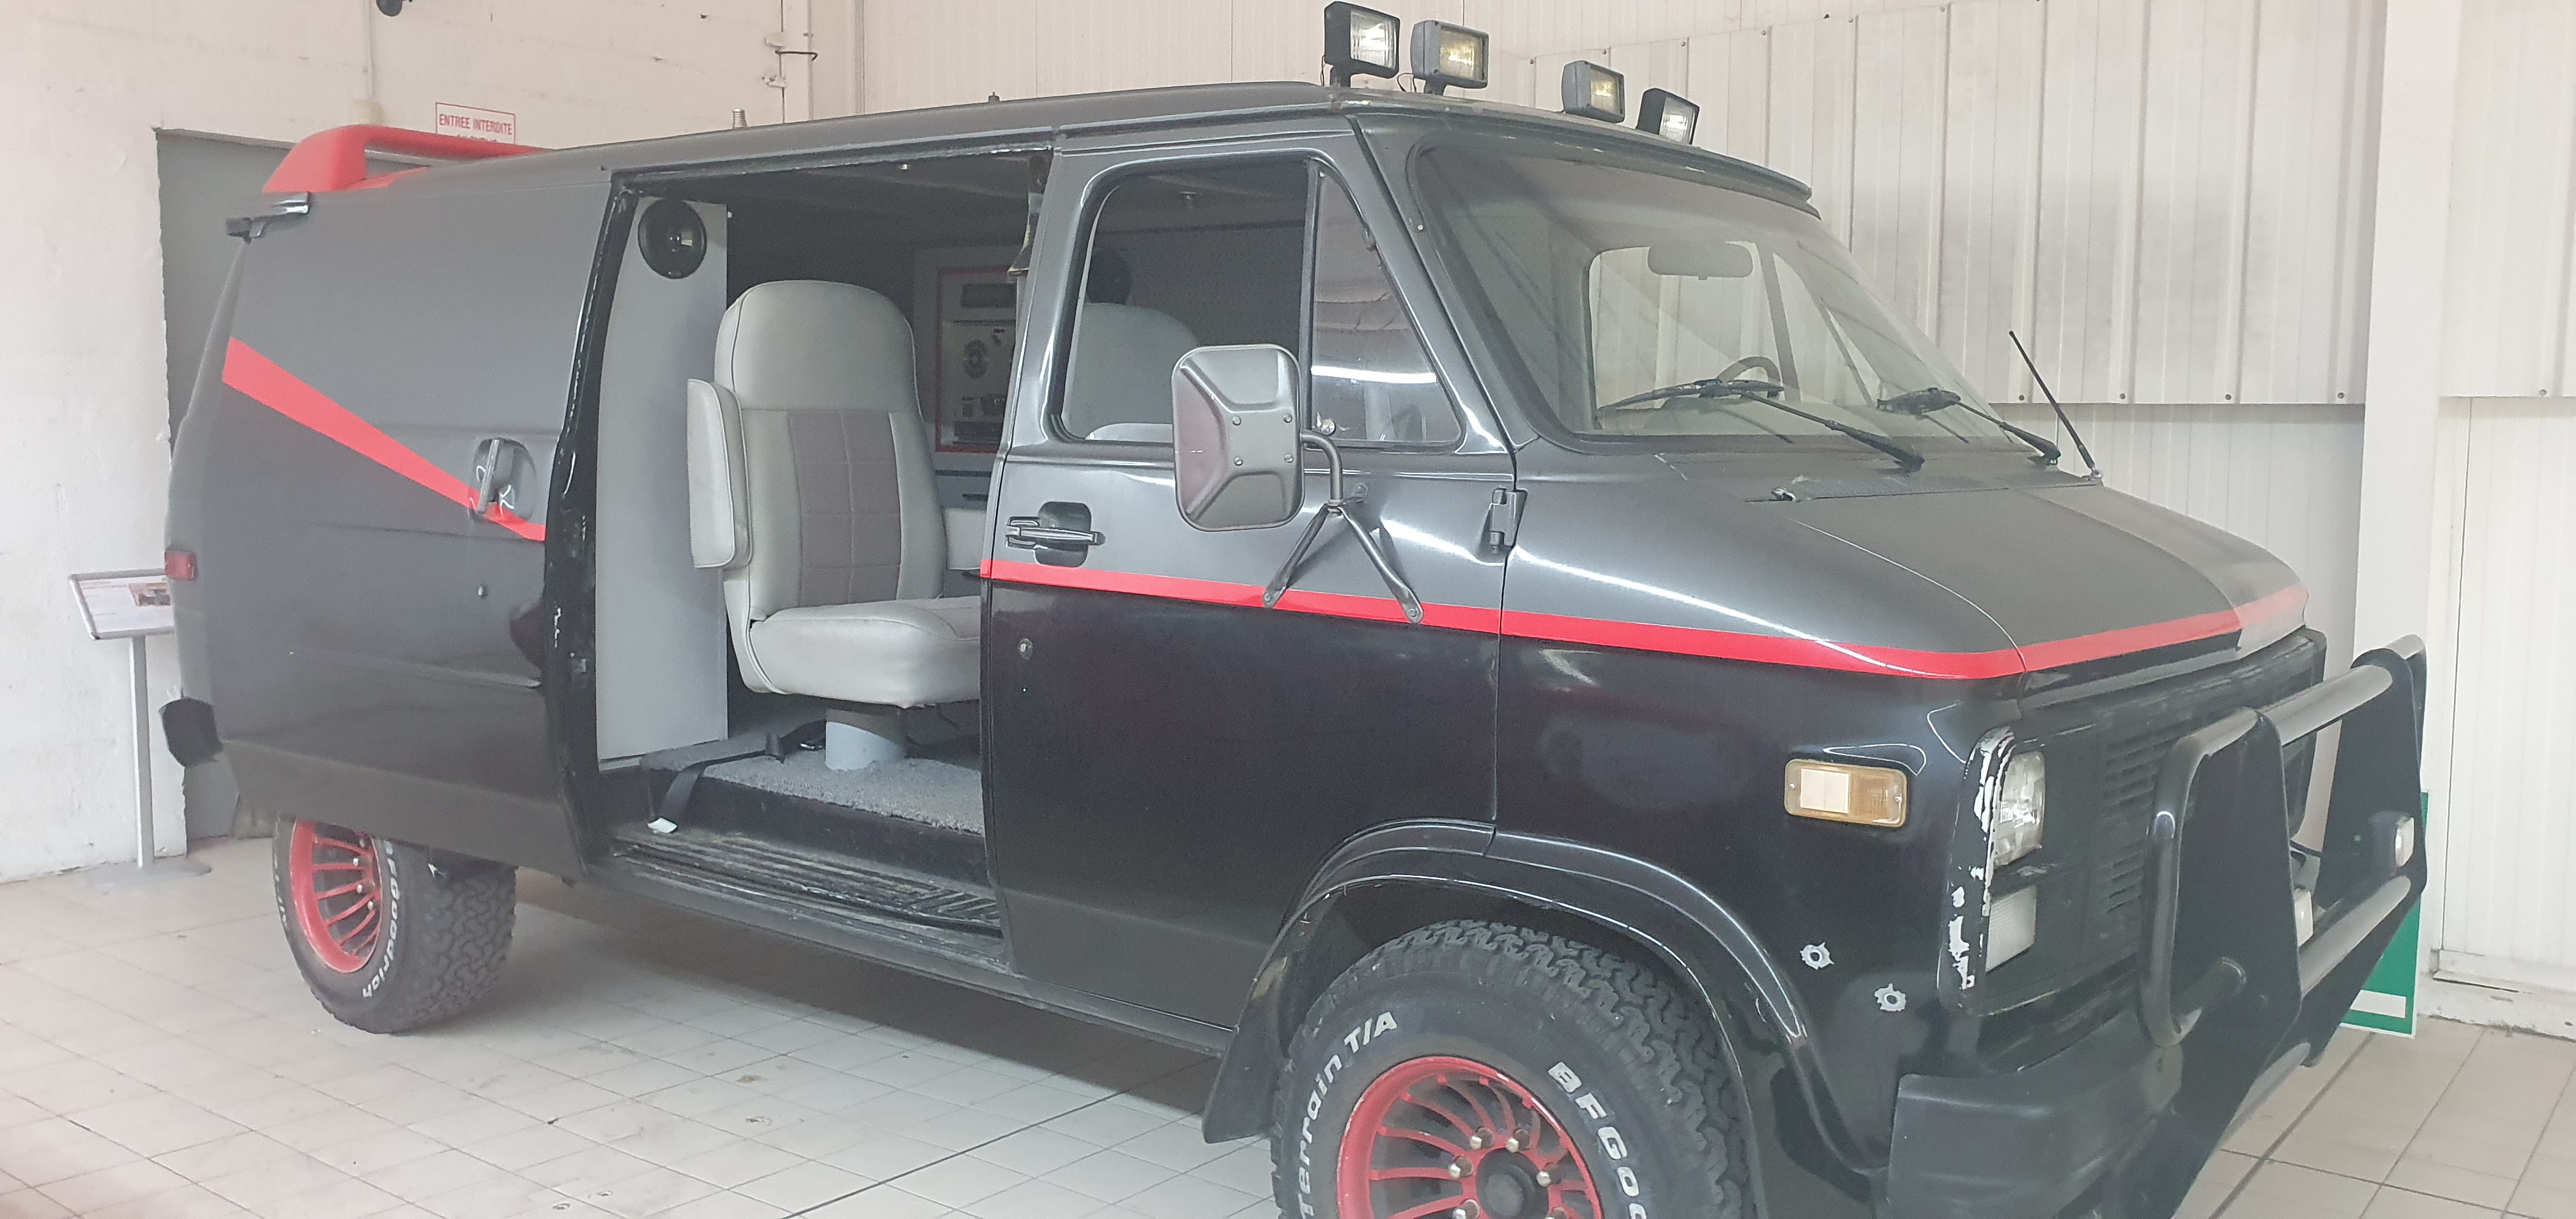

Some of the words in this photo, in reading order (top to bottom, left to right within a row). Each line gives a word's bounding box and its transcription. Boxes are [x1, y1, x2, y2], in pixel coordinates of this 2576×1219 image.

[439, 114, 470, 129] ENTREE
[473, 118, 512, 135] INTERDITE
[1297, 1054, 1342, 1219] Terrain
[1344, 1011, 1398, 1054] T/A
